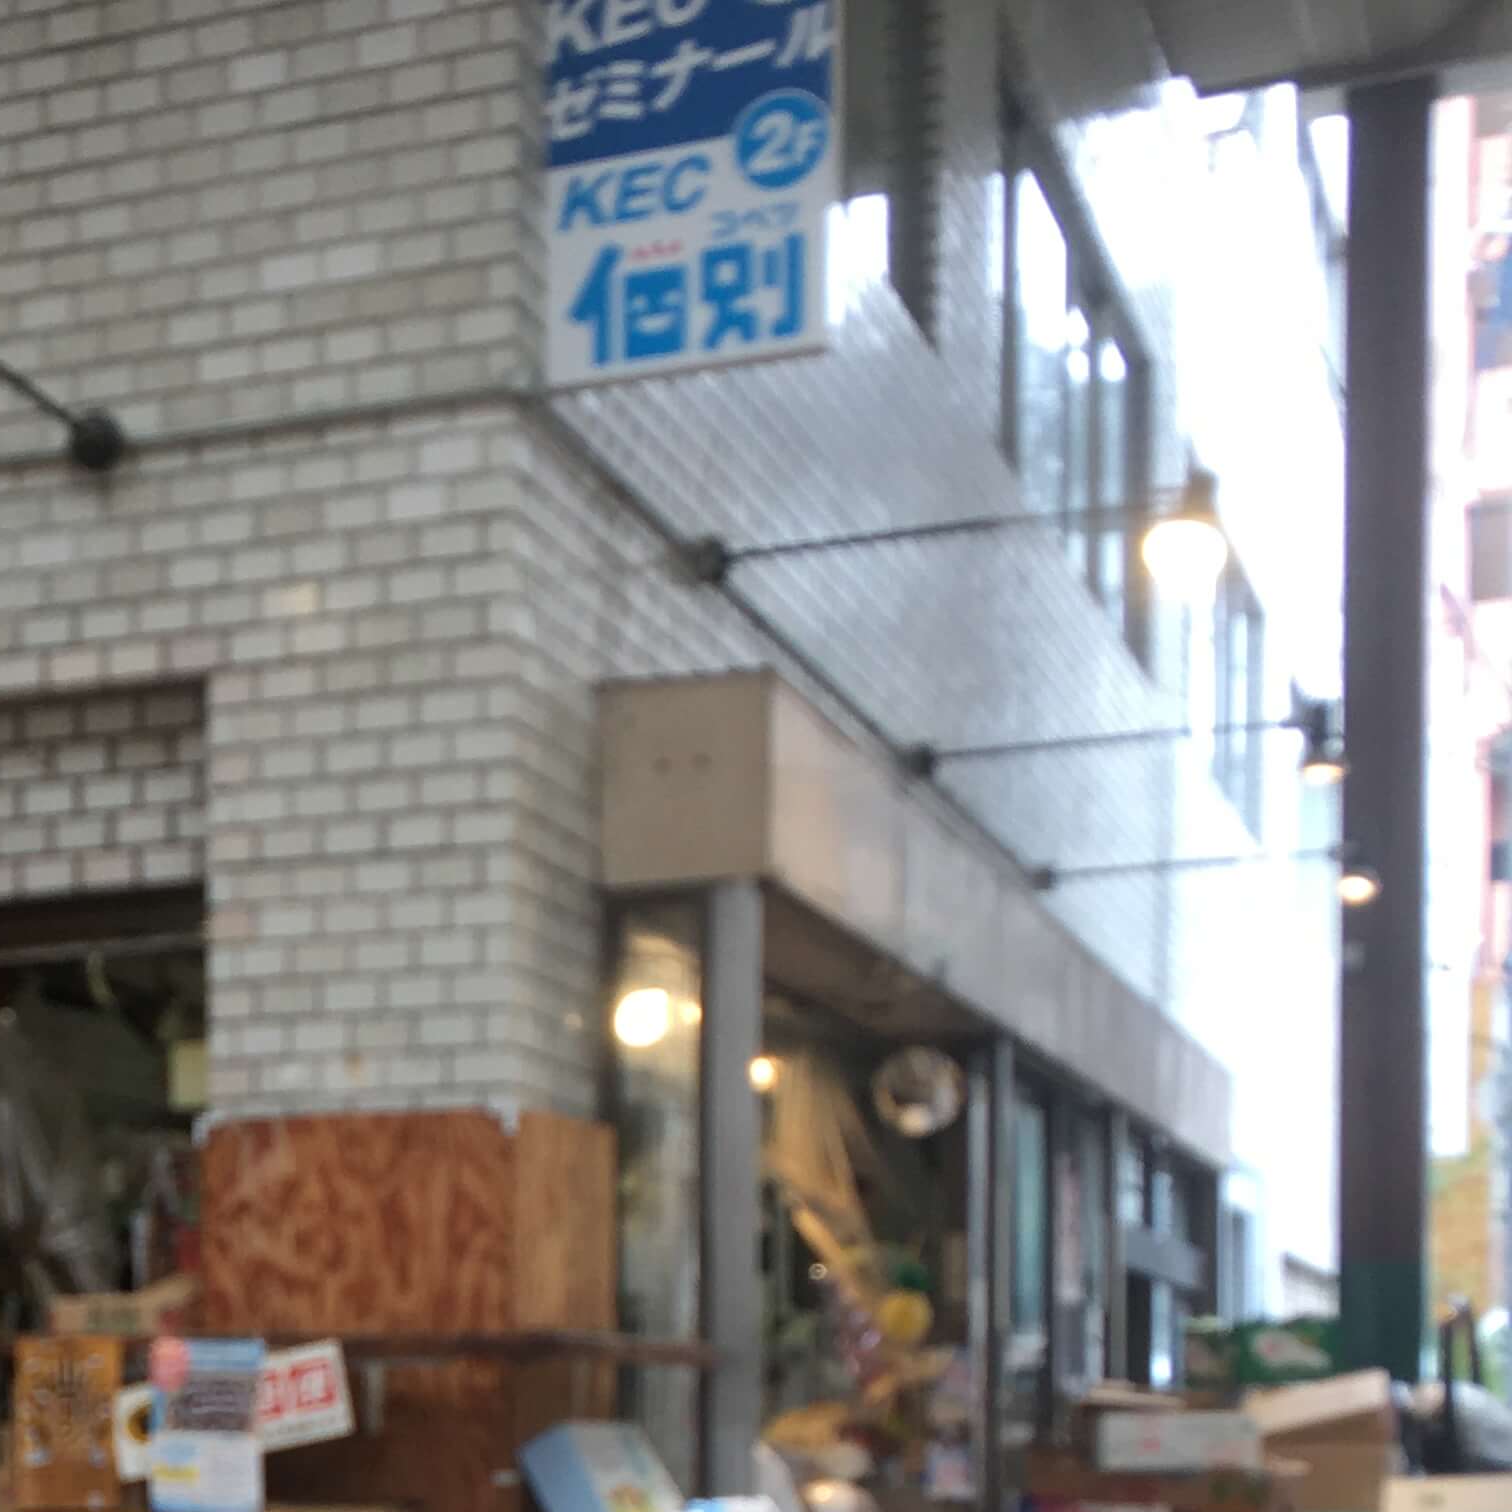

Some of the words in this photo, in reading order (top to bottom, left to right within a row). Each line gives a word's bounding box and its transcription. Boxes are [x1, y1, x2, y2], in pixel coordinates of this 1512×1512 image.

[548, 4, 836, 142] ゼミナール
[556, 153, 712, 233] KEC
[568, 232, 804, 366] 個別
